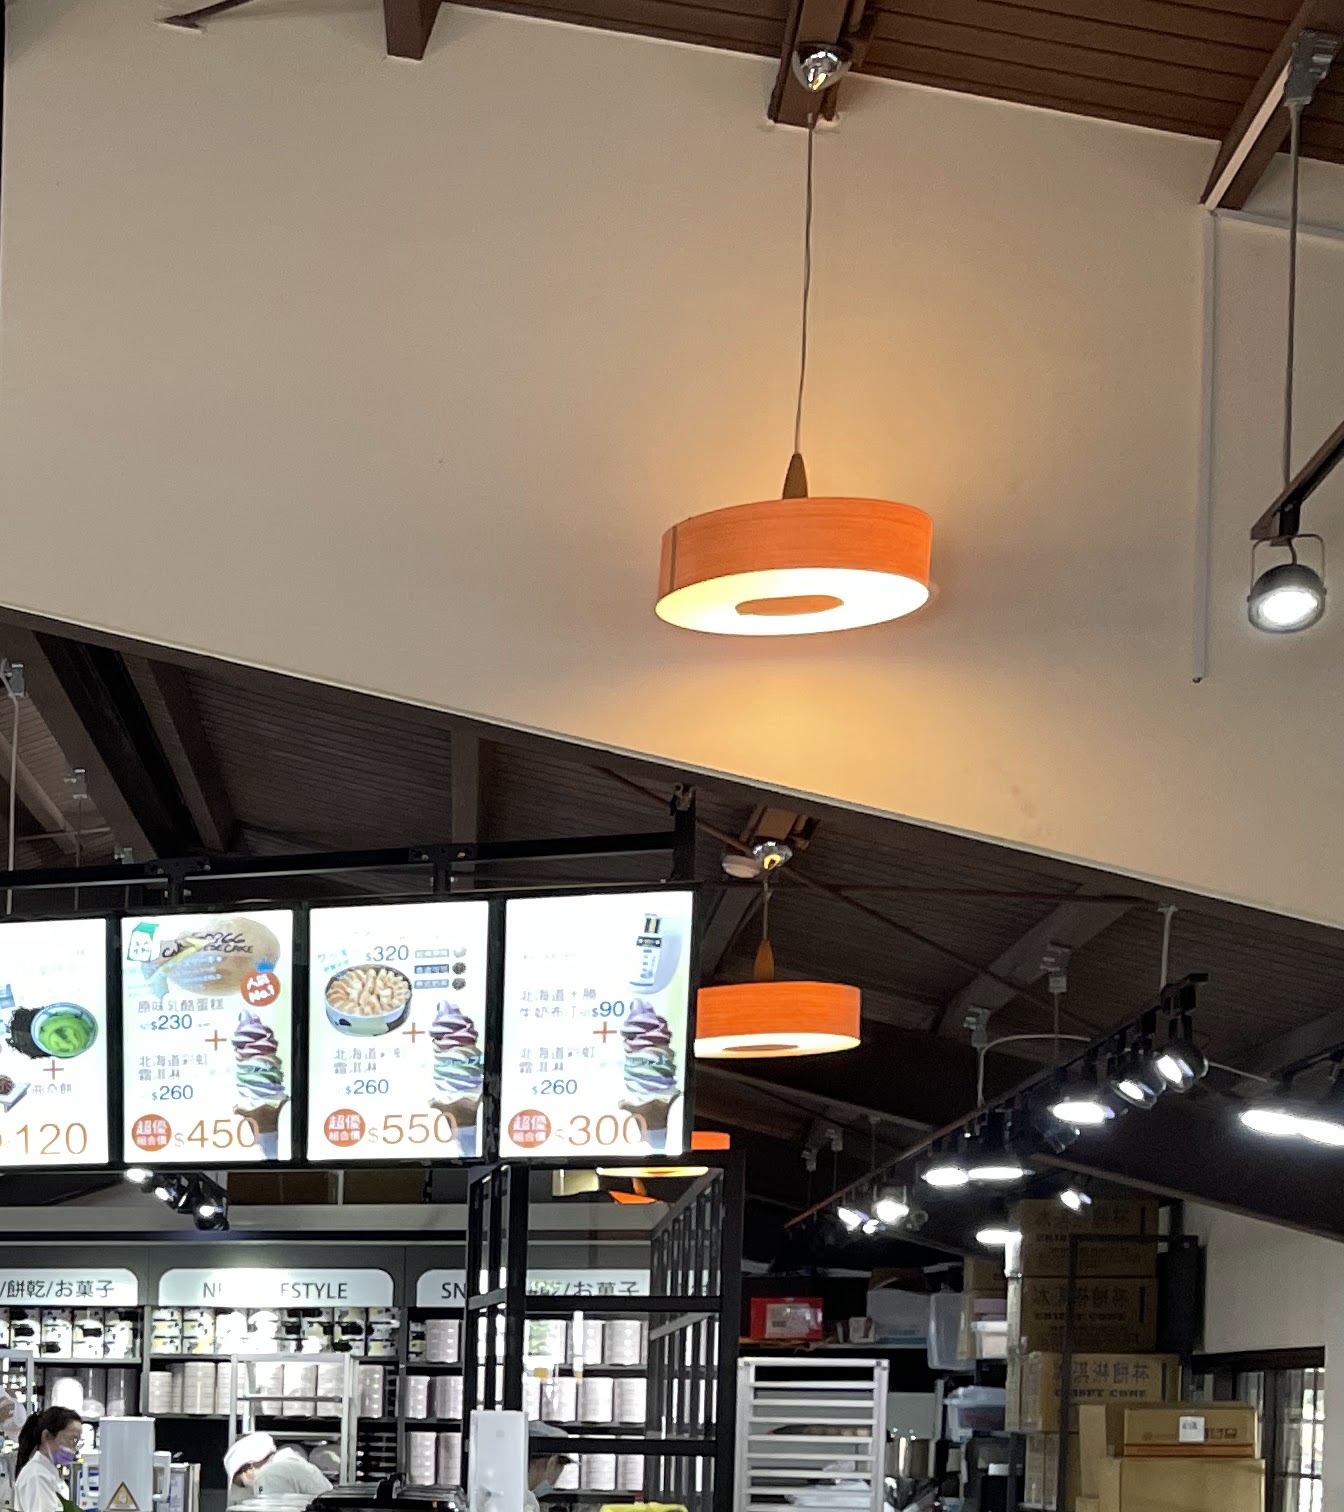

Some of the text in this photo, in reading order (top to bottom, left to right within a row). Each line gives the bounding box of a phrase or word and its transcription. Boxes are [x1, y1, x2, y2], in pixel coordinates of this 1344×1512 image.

[366, 945, 409, 962] $320
[152, 1085, 194, 1101] $260
[345, 1078, 389, 1095] $260
[532, 1079, 578, 1095] $260
[174, 1119, 259, 1149] $450
[368, 1111, 458, 1145] $550
